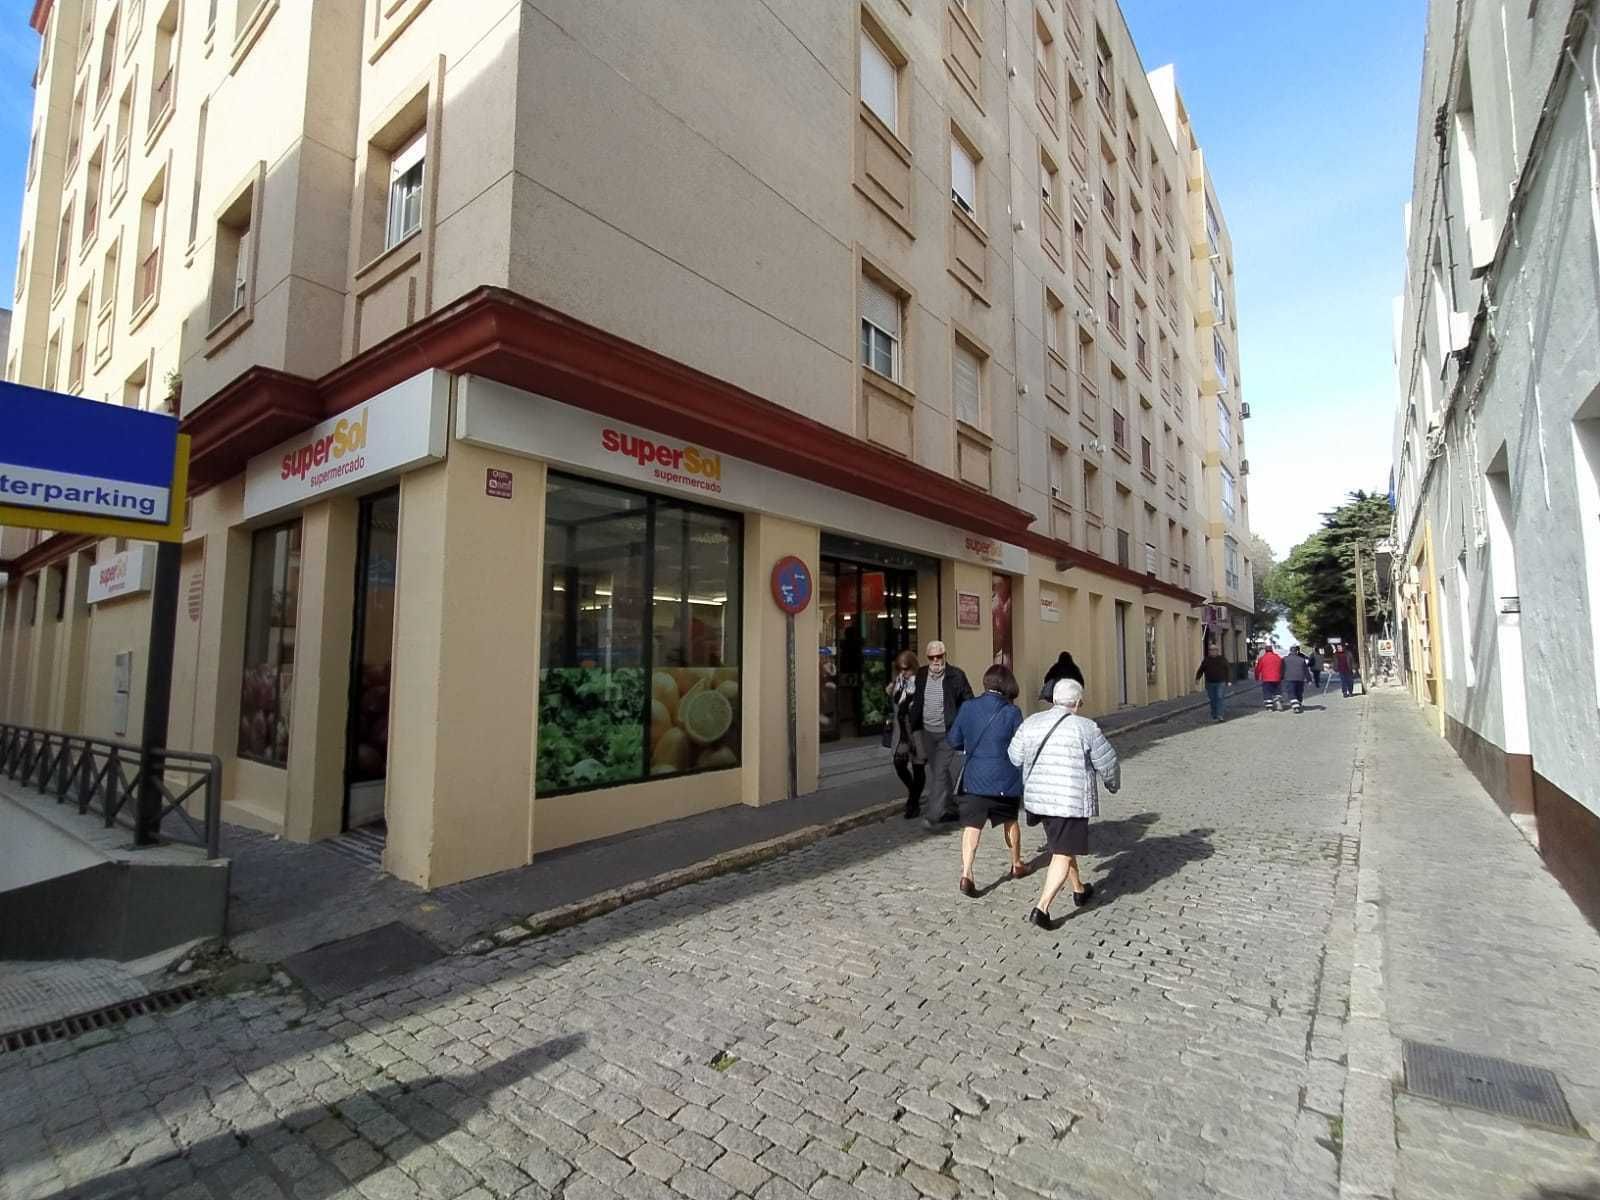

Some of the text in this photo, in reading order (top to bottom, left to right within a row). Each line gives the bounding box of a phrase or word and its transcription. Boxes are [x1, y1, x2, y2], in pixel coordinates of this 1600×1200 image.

[281, 406, 369, 481] superSol
[602, 428, 720, 481] superSol
[310, 455, 365, 488] supermercado
[654, 468, 721, 494] supermercado
[0, 474, 155, 515] terparking
